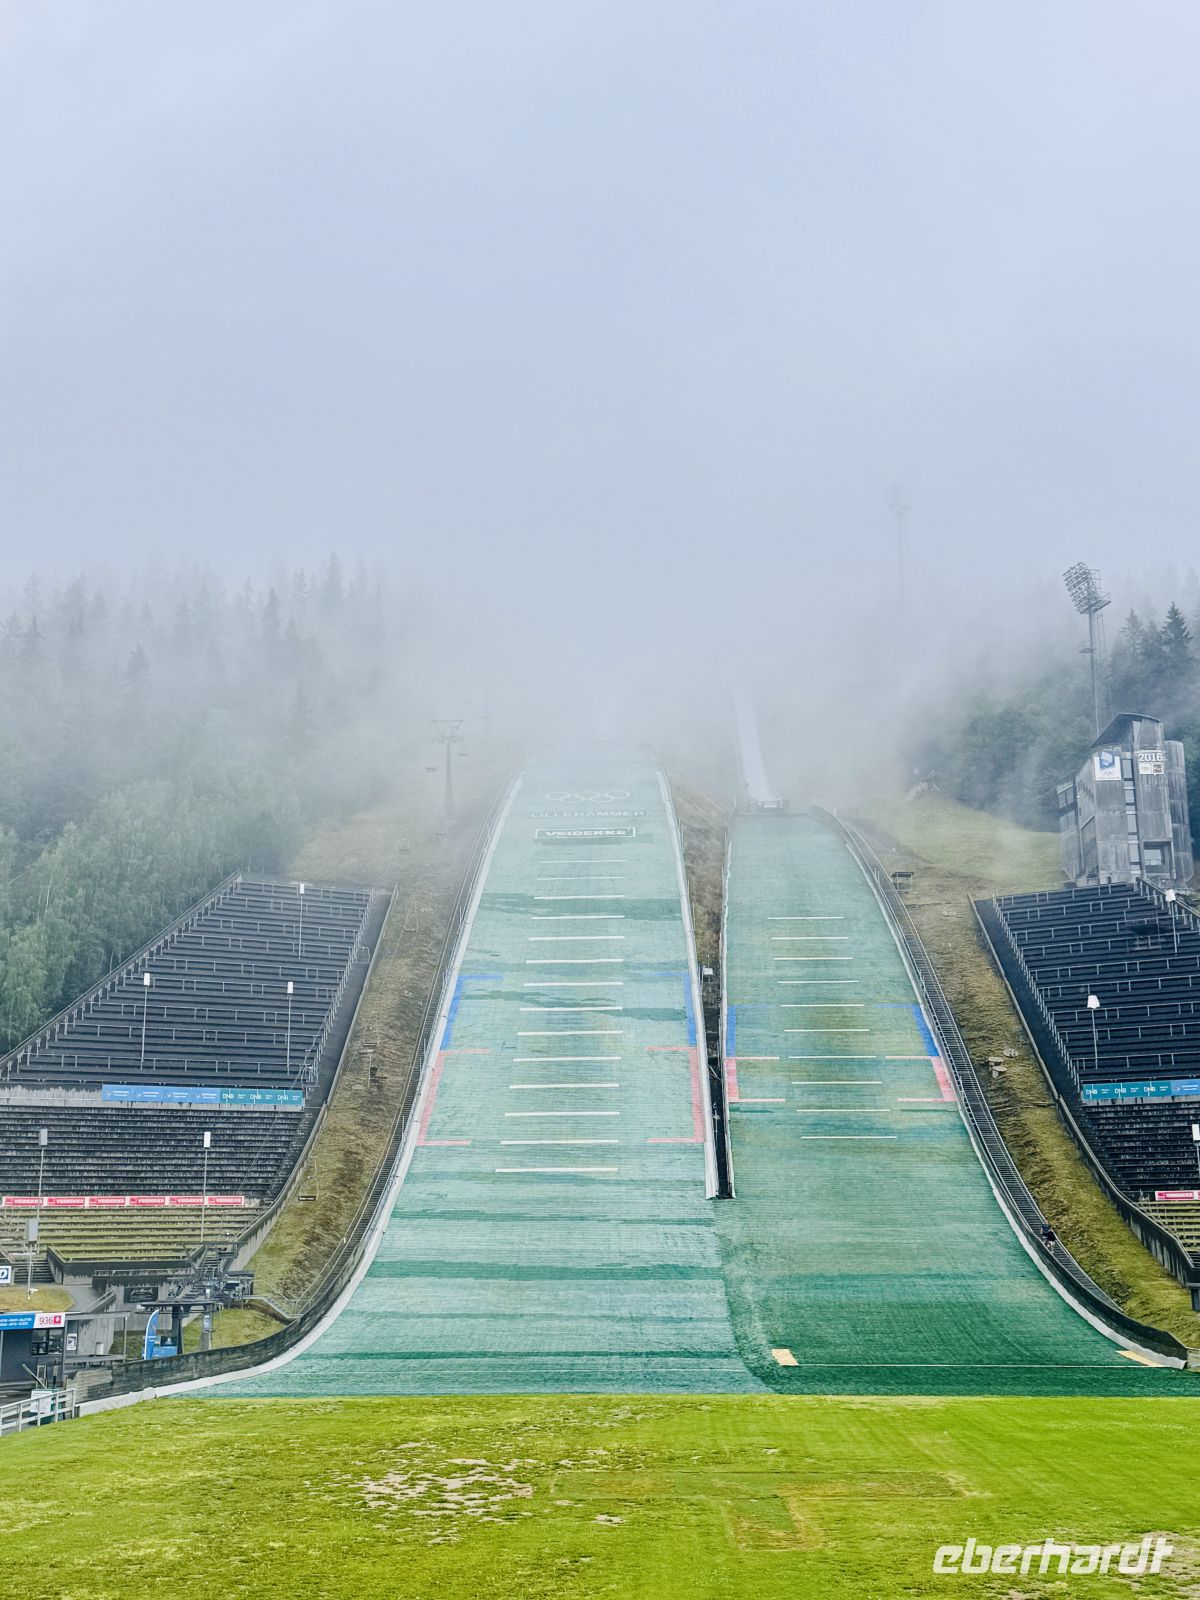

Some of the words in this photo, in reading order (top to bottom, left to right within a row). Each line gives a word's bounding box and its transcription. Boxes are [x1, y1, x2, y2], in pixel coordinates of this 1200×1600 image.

[1138, 753, 1163, 762] 2016
[531, 810, 646, 818] LILLEHAMMER
[39, 1316, 53, 1325] 936
